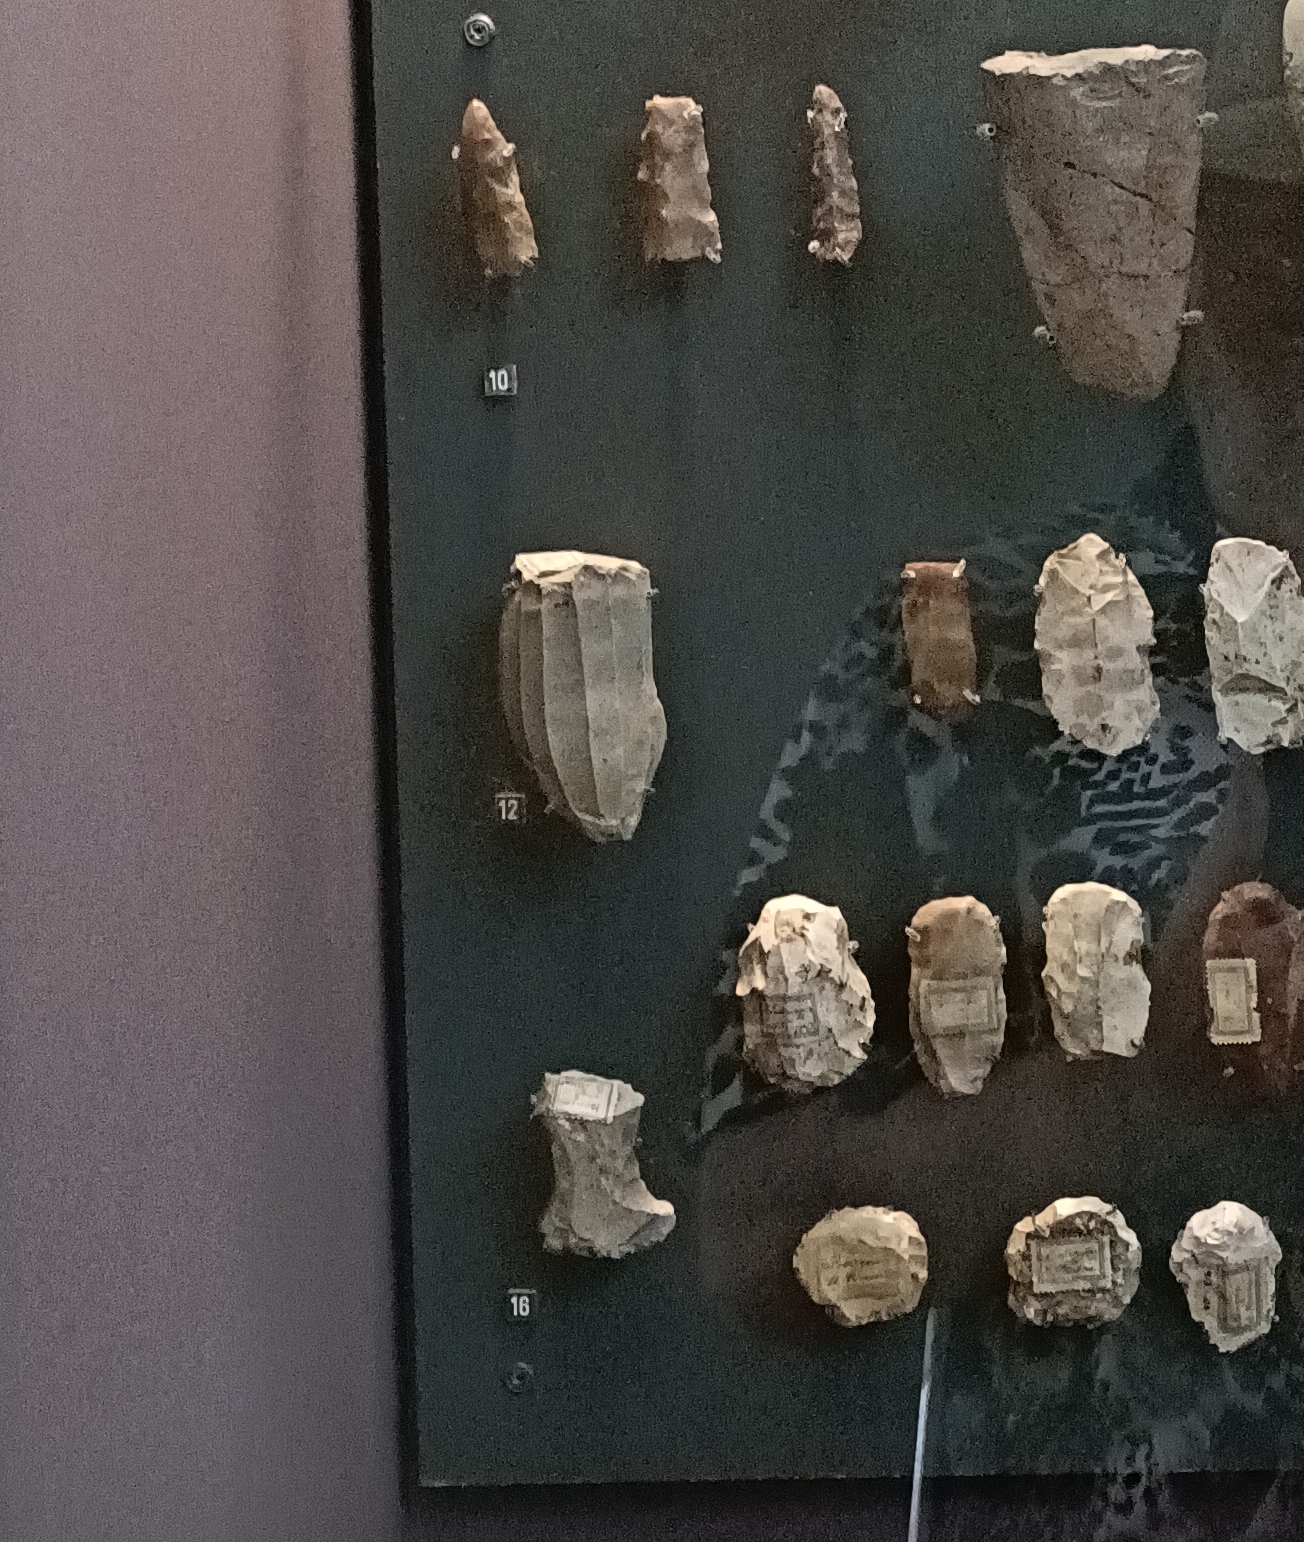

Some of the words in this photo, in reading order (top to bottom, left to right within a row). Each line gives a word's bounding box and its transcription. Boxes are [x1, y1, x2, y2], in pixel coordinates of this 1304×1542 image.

[489, 369, 508, 390] 10
[499, 799, 518, 820] 12
[511, 1296, 530, 1316] 16
